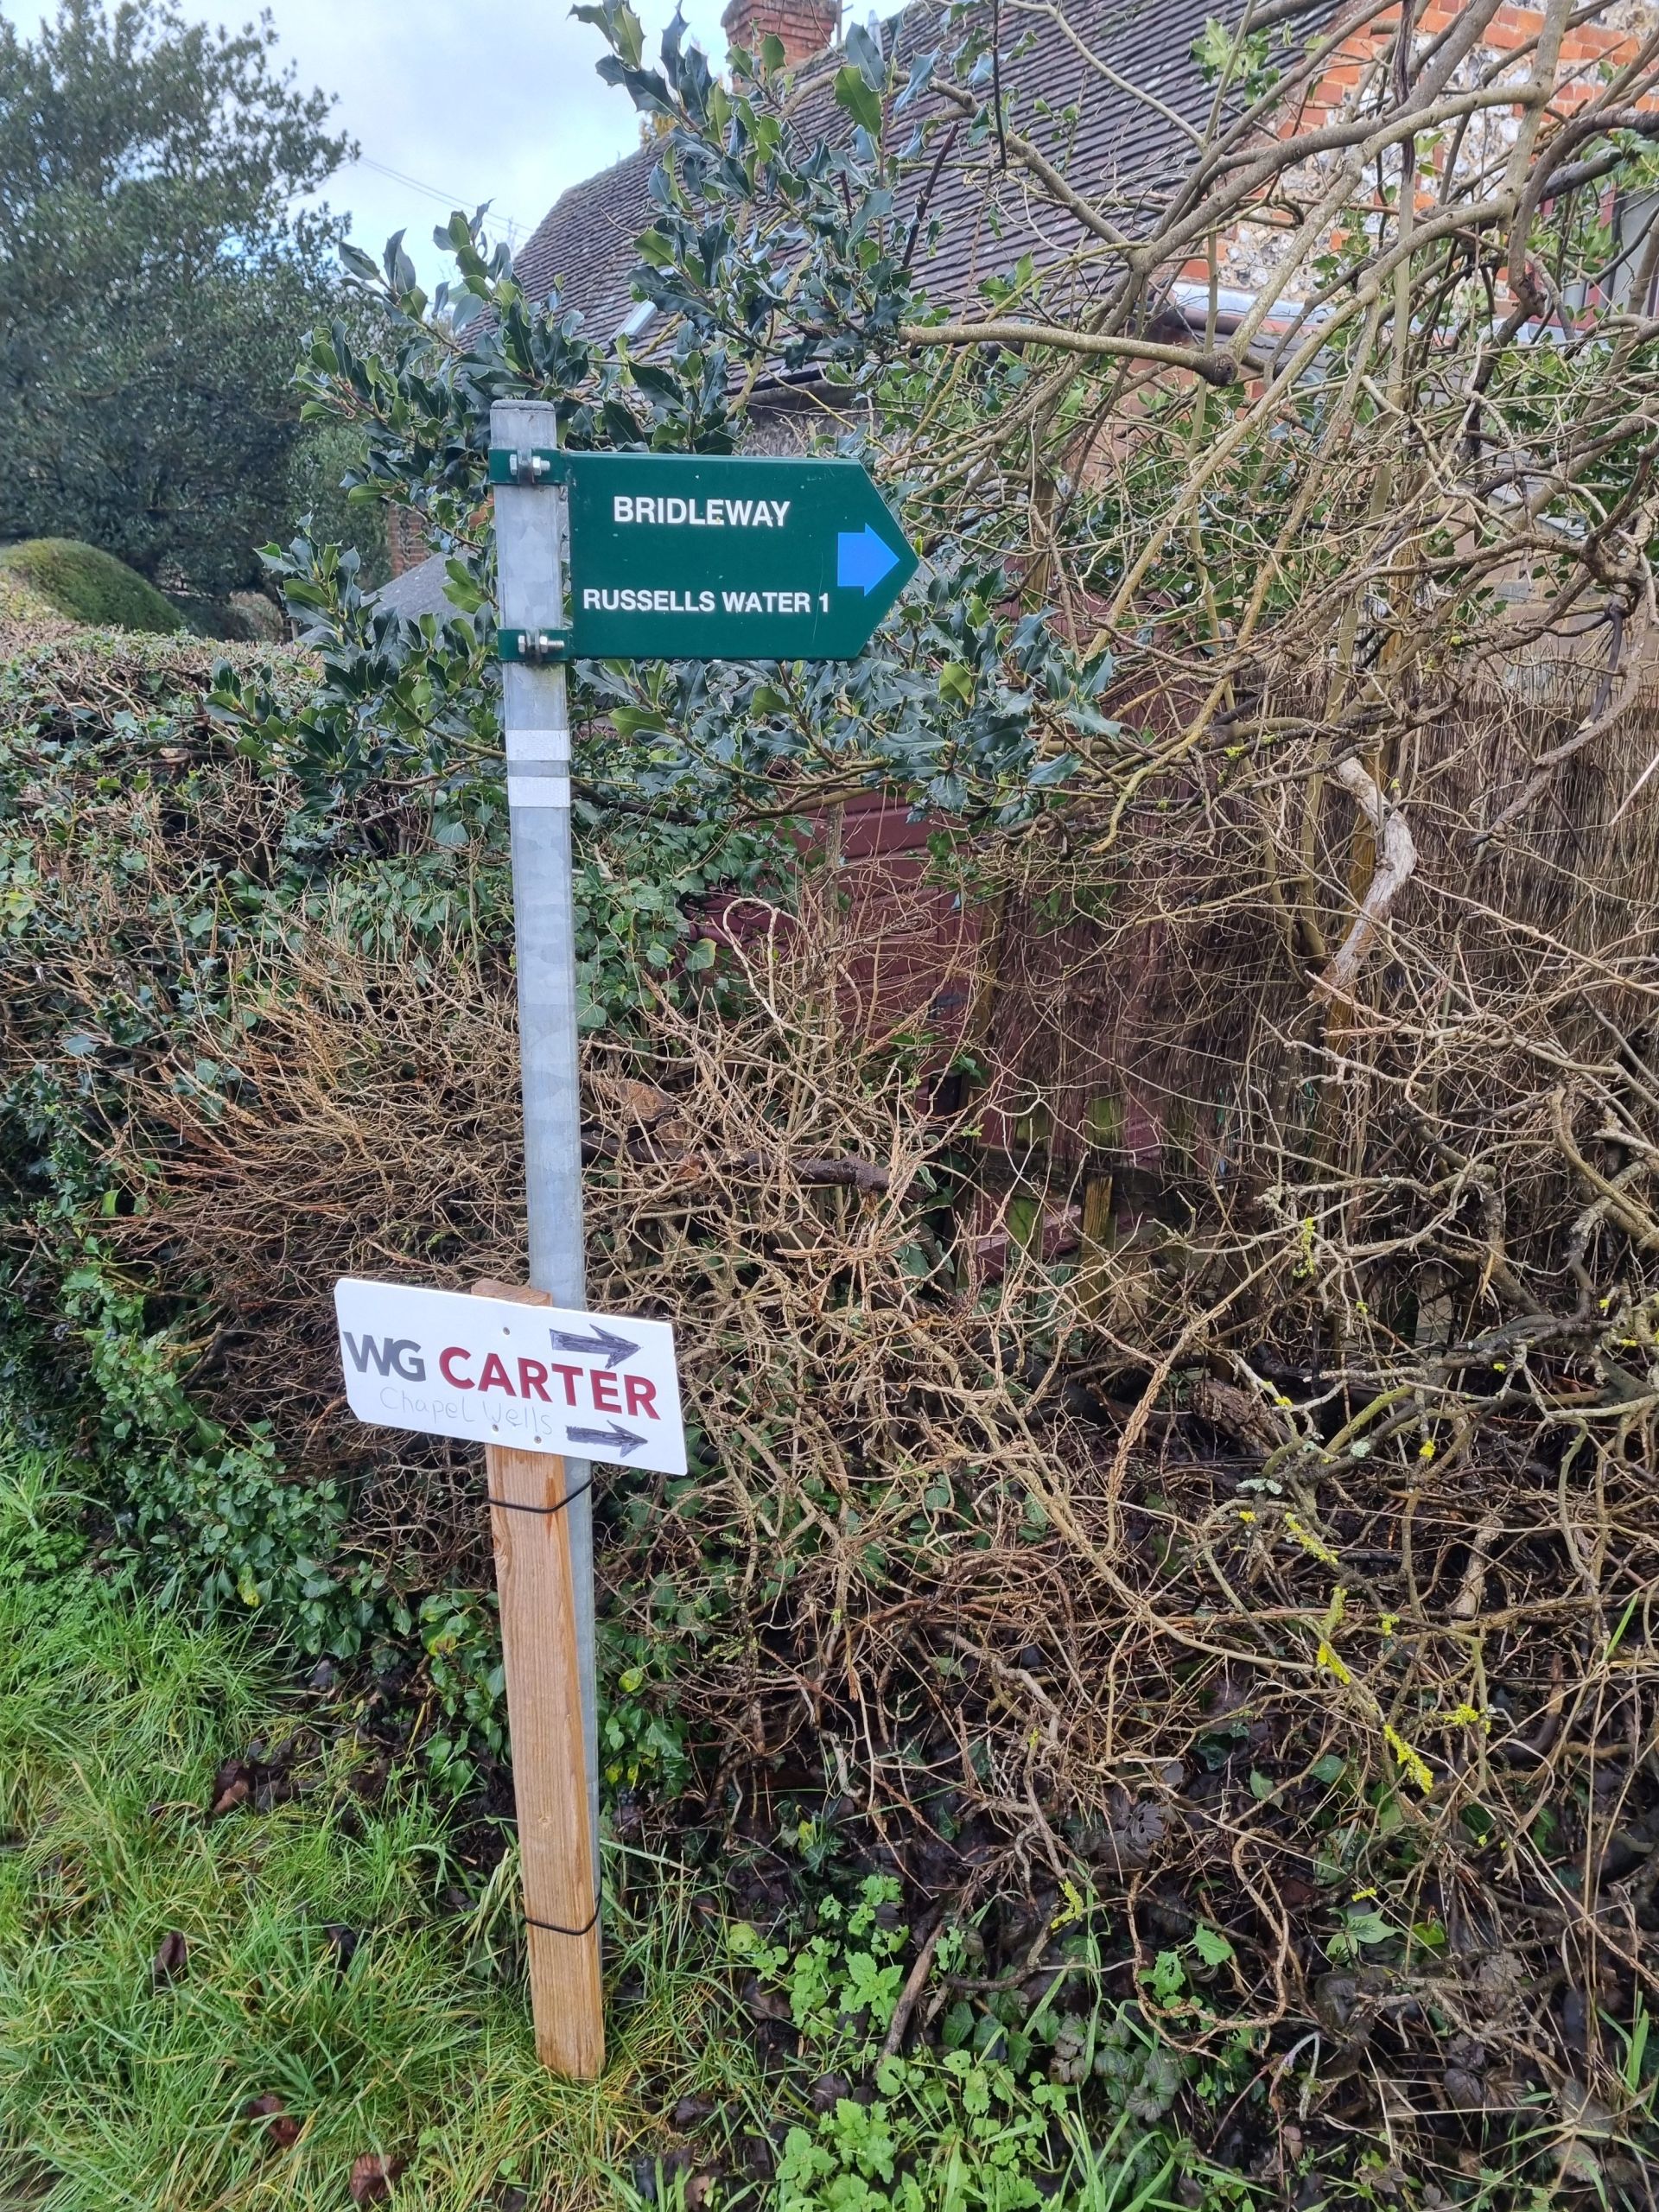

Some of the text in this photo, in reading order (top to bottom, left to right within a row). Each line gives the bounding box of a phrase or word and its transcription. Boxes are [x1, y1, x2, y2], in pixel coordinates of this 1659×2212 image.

[613, 496, 790, 526] BRIDLEWAY
[583, 588, 830, 613] RUSSELLS WATER 1
[343, 1332, 661, 1420] WG CARTER
[379, 1386, 553, 1435] Chapel Wells
